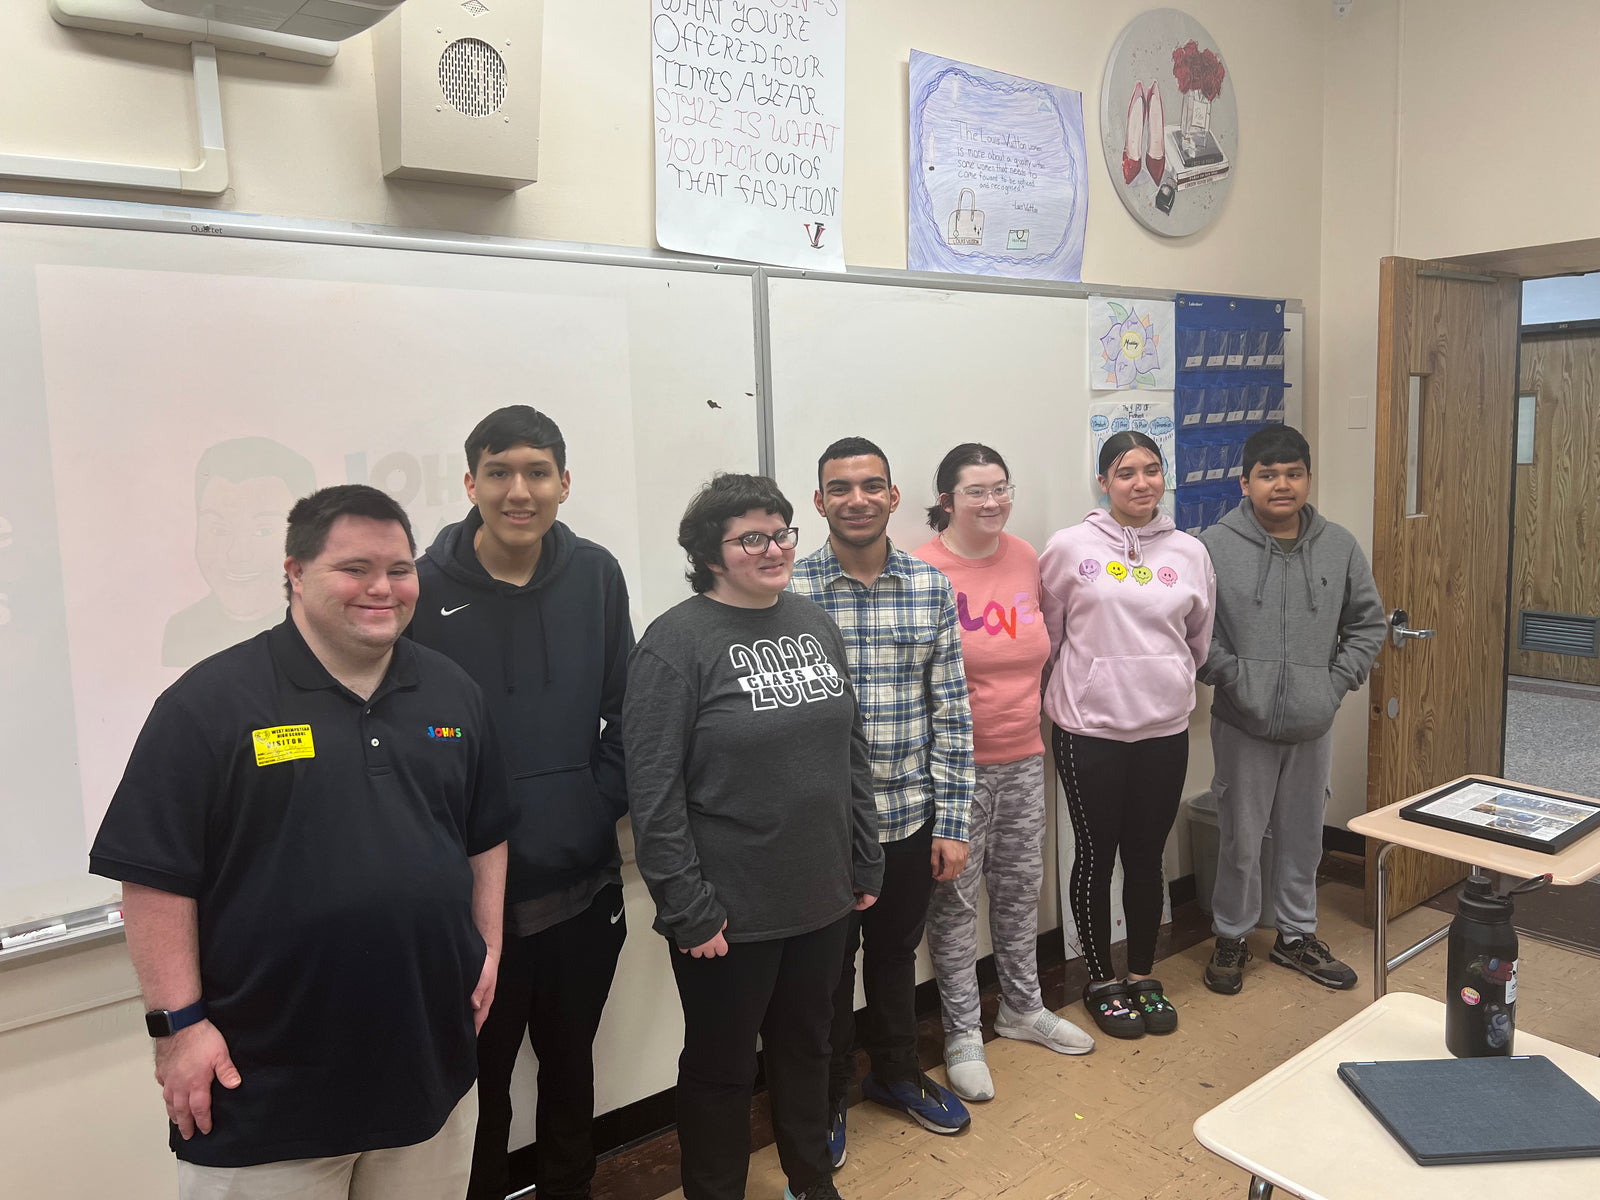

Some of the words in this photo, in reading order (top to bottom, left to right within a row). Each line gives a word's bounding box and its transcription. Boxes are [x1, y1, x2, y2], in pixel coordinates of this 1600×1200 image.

[656, 55, 732, 102] TIMES
[737, 72, 756, 102] A
[656, 88, 724, 129] STYLE
[733, 109, 762, 139] IS
[769, 114, 840, 153] WHAT
[659, 128, 707, 164] YOU
[711, 138, 763, 172] PICK
[765, 152, 801, 175] OUT
[666, 164, 729, 197] THAT
[191, 224, 223, 234] Qutet
[956, 591, 1035, 639] LOVE
[746, 669, 806, 689] CLASS
[812, 664, 831, 677] OF
[267, 738, 302, 749] VISITOR
